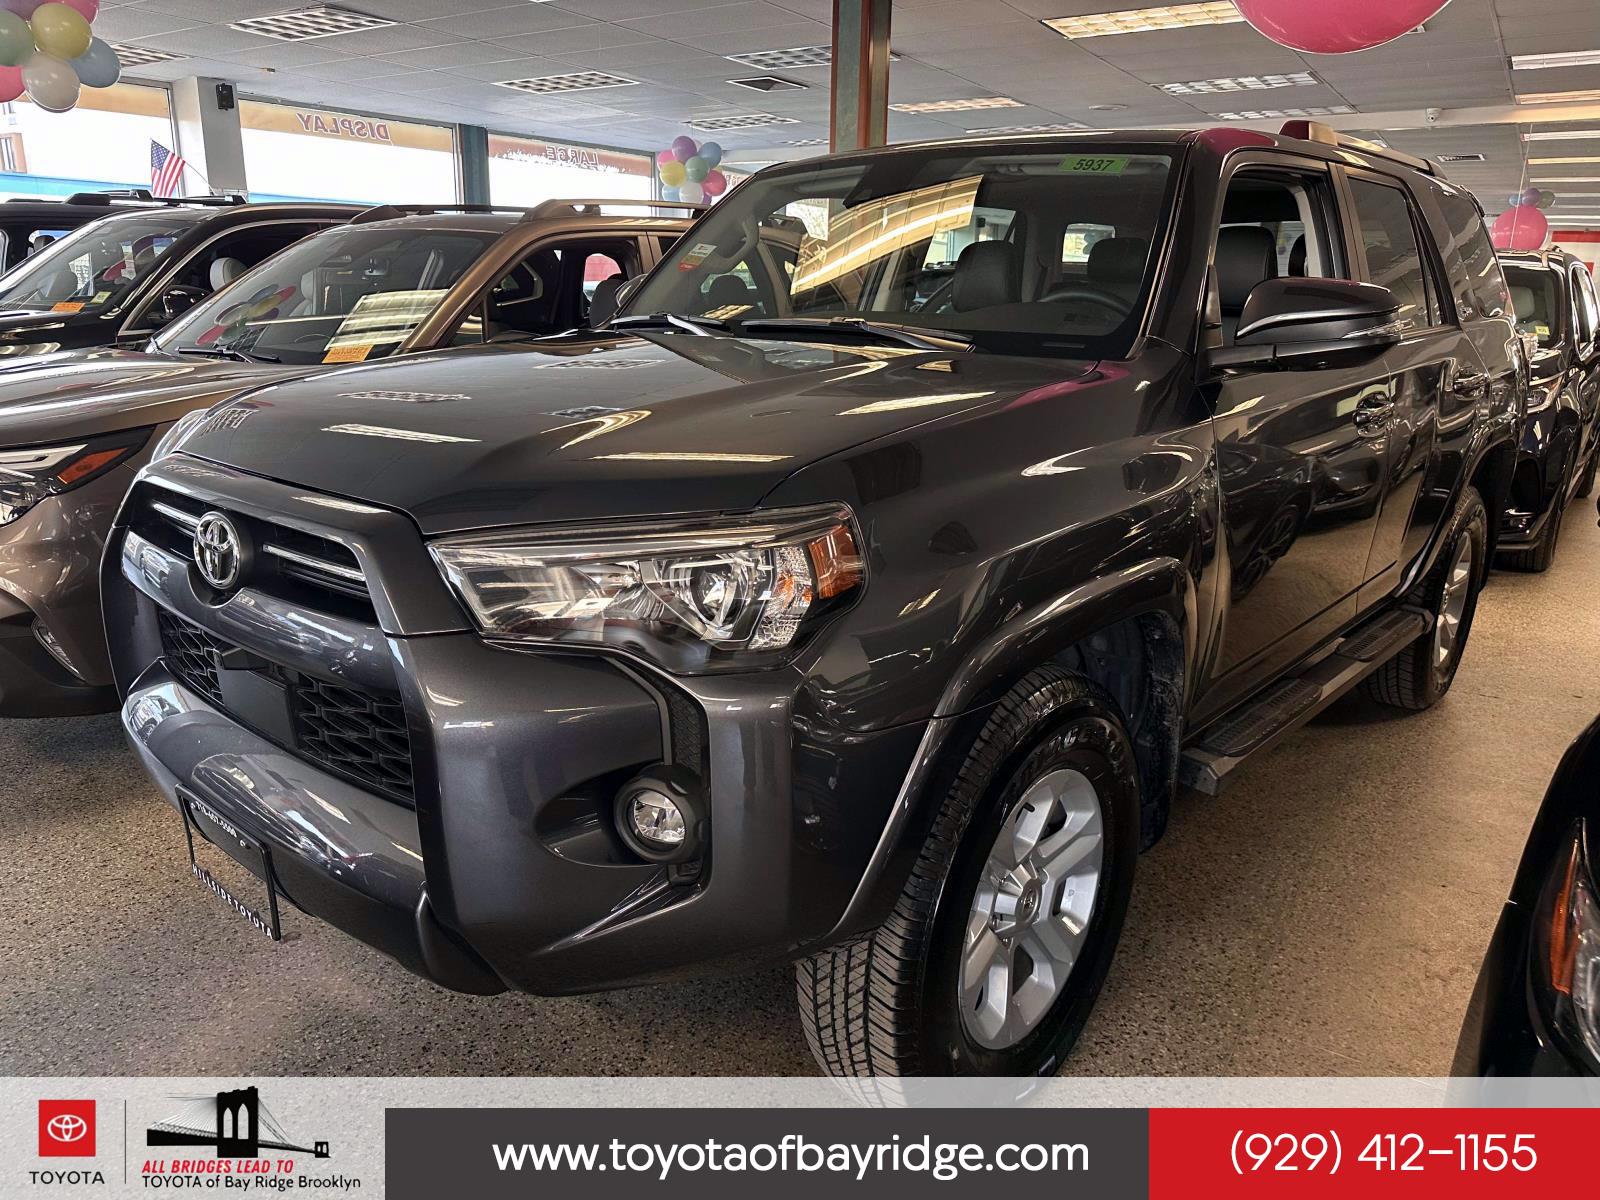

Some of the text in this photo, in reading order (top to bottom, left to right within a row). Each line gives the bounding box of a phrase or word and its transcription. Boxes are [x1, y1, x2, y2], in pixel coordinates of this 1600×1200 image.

[1072, 158, 1115, 172] 5937
[191, 863, 274, 940] HILLSIDE TOYOTA
